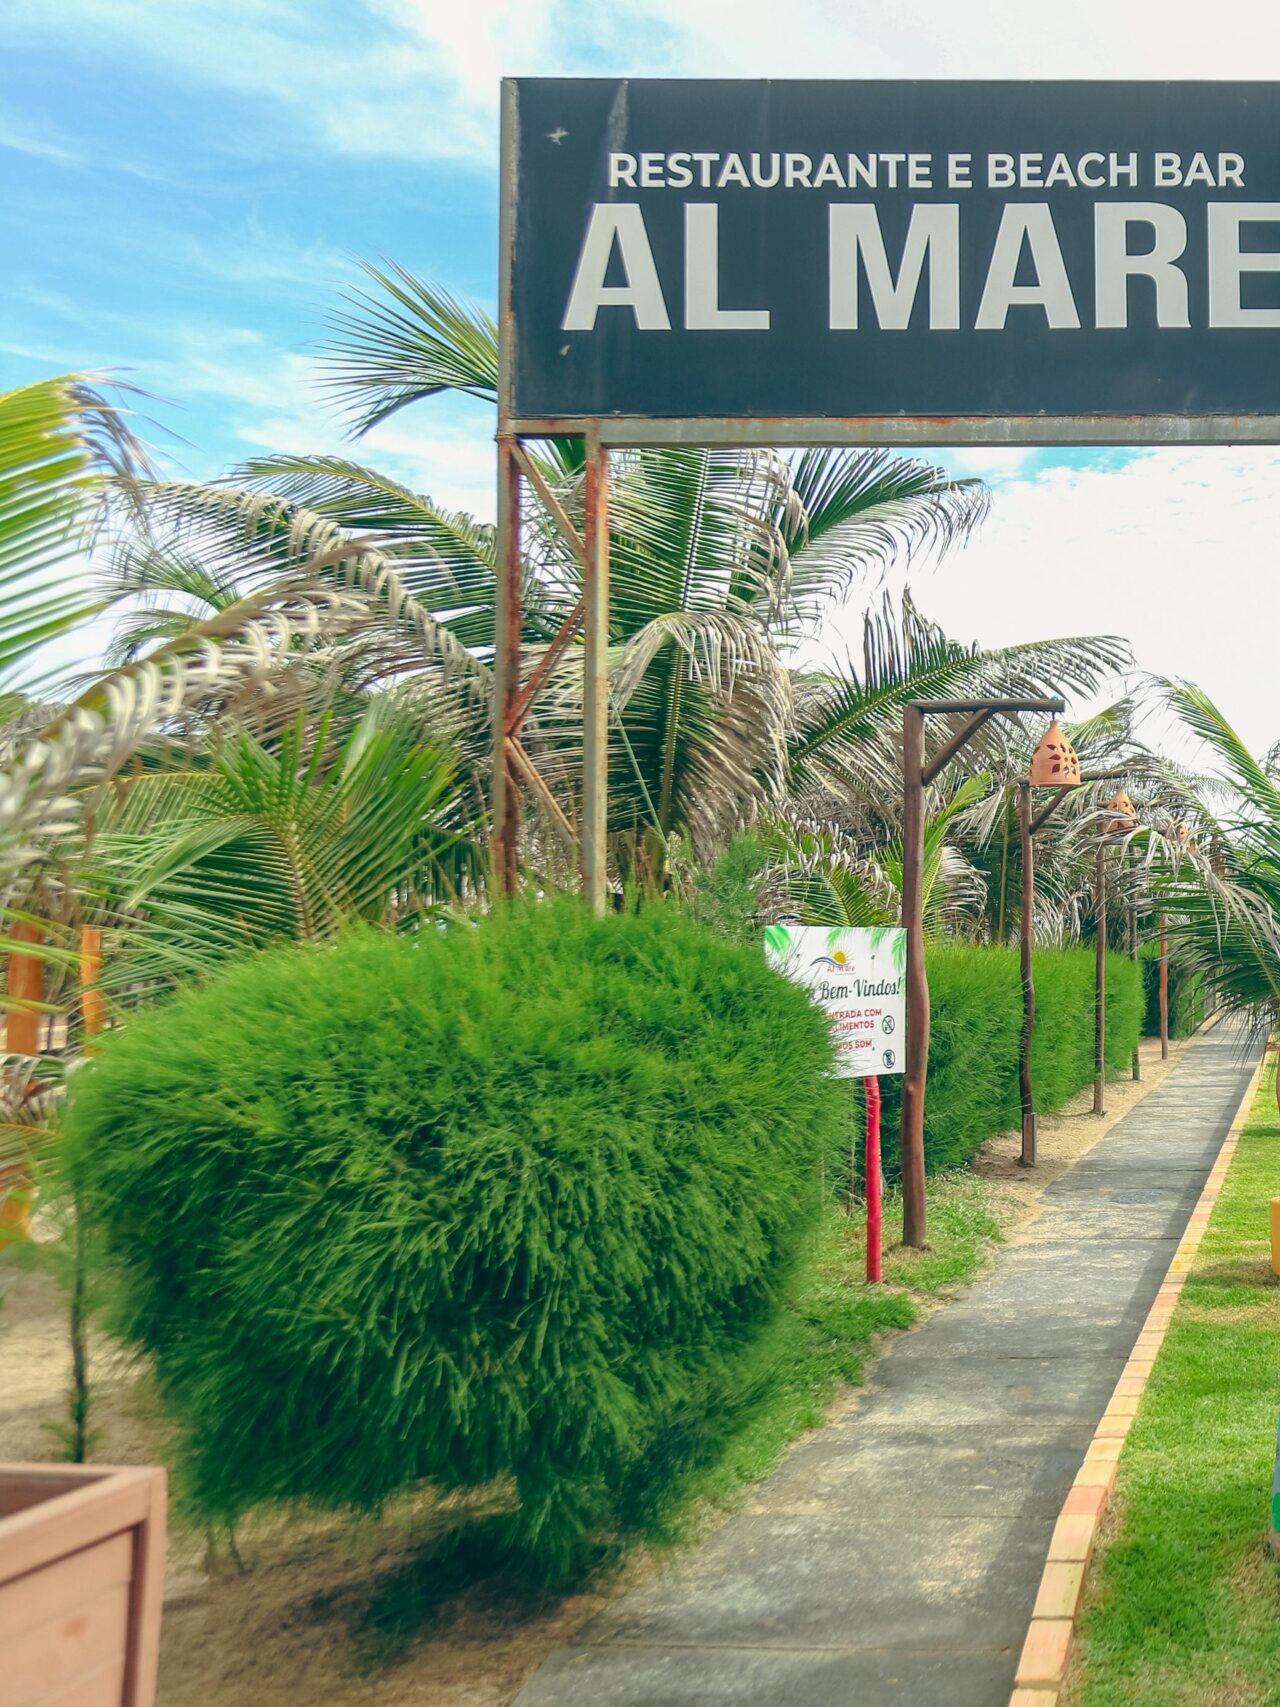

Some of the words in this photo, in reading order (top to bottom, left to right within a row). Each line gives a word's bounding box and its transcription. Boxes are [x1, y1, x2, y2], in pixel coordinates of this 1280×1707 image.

[608, 152, 933, 188] RESTAURANTE
[947, 153, 973, 188] E
[987, 153, 1138, 188] BEACH
[1154, 152, 1245, 187] BAR
[561, 202, 770, 330] AL
[820, 977, 901, 1000] Bem-Vindos!
[864, 1008, 882, 1017] COM
[855, 1040, 872, 1049] SOM
